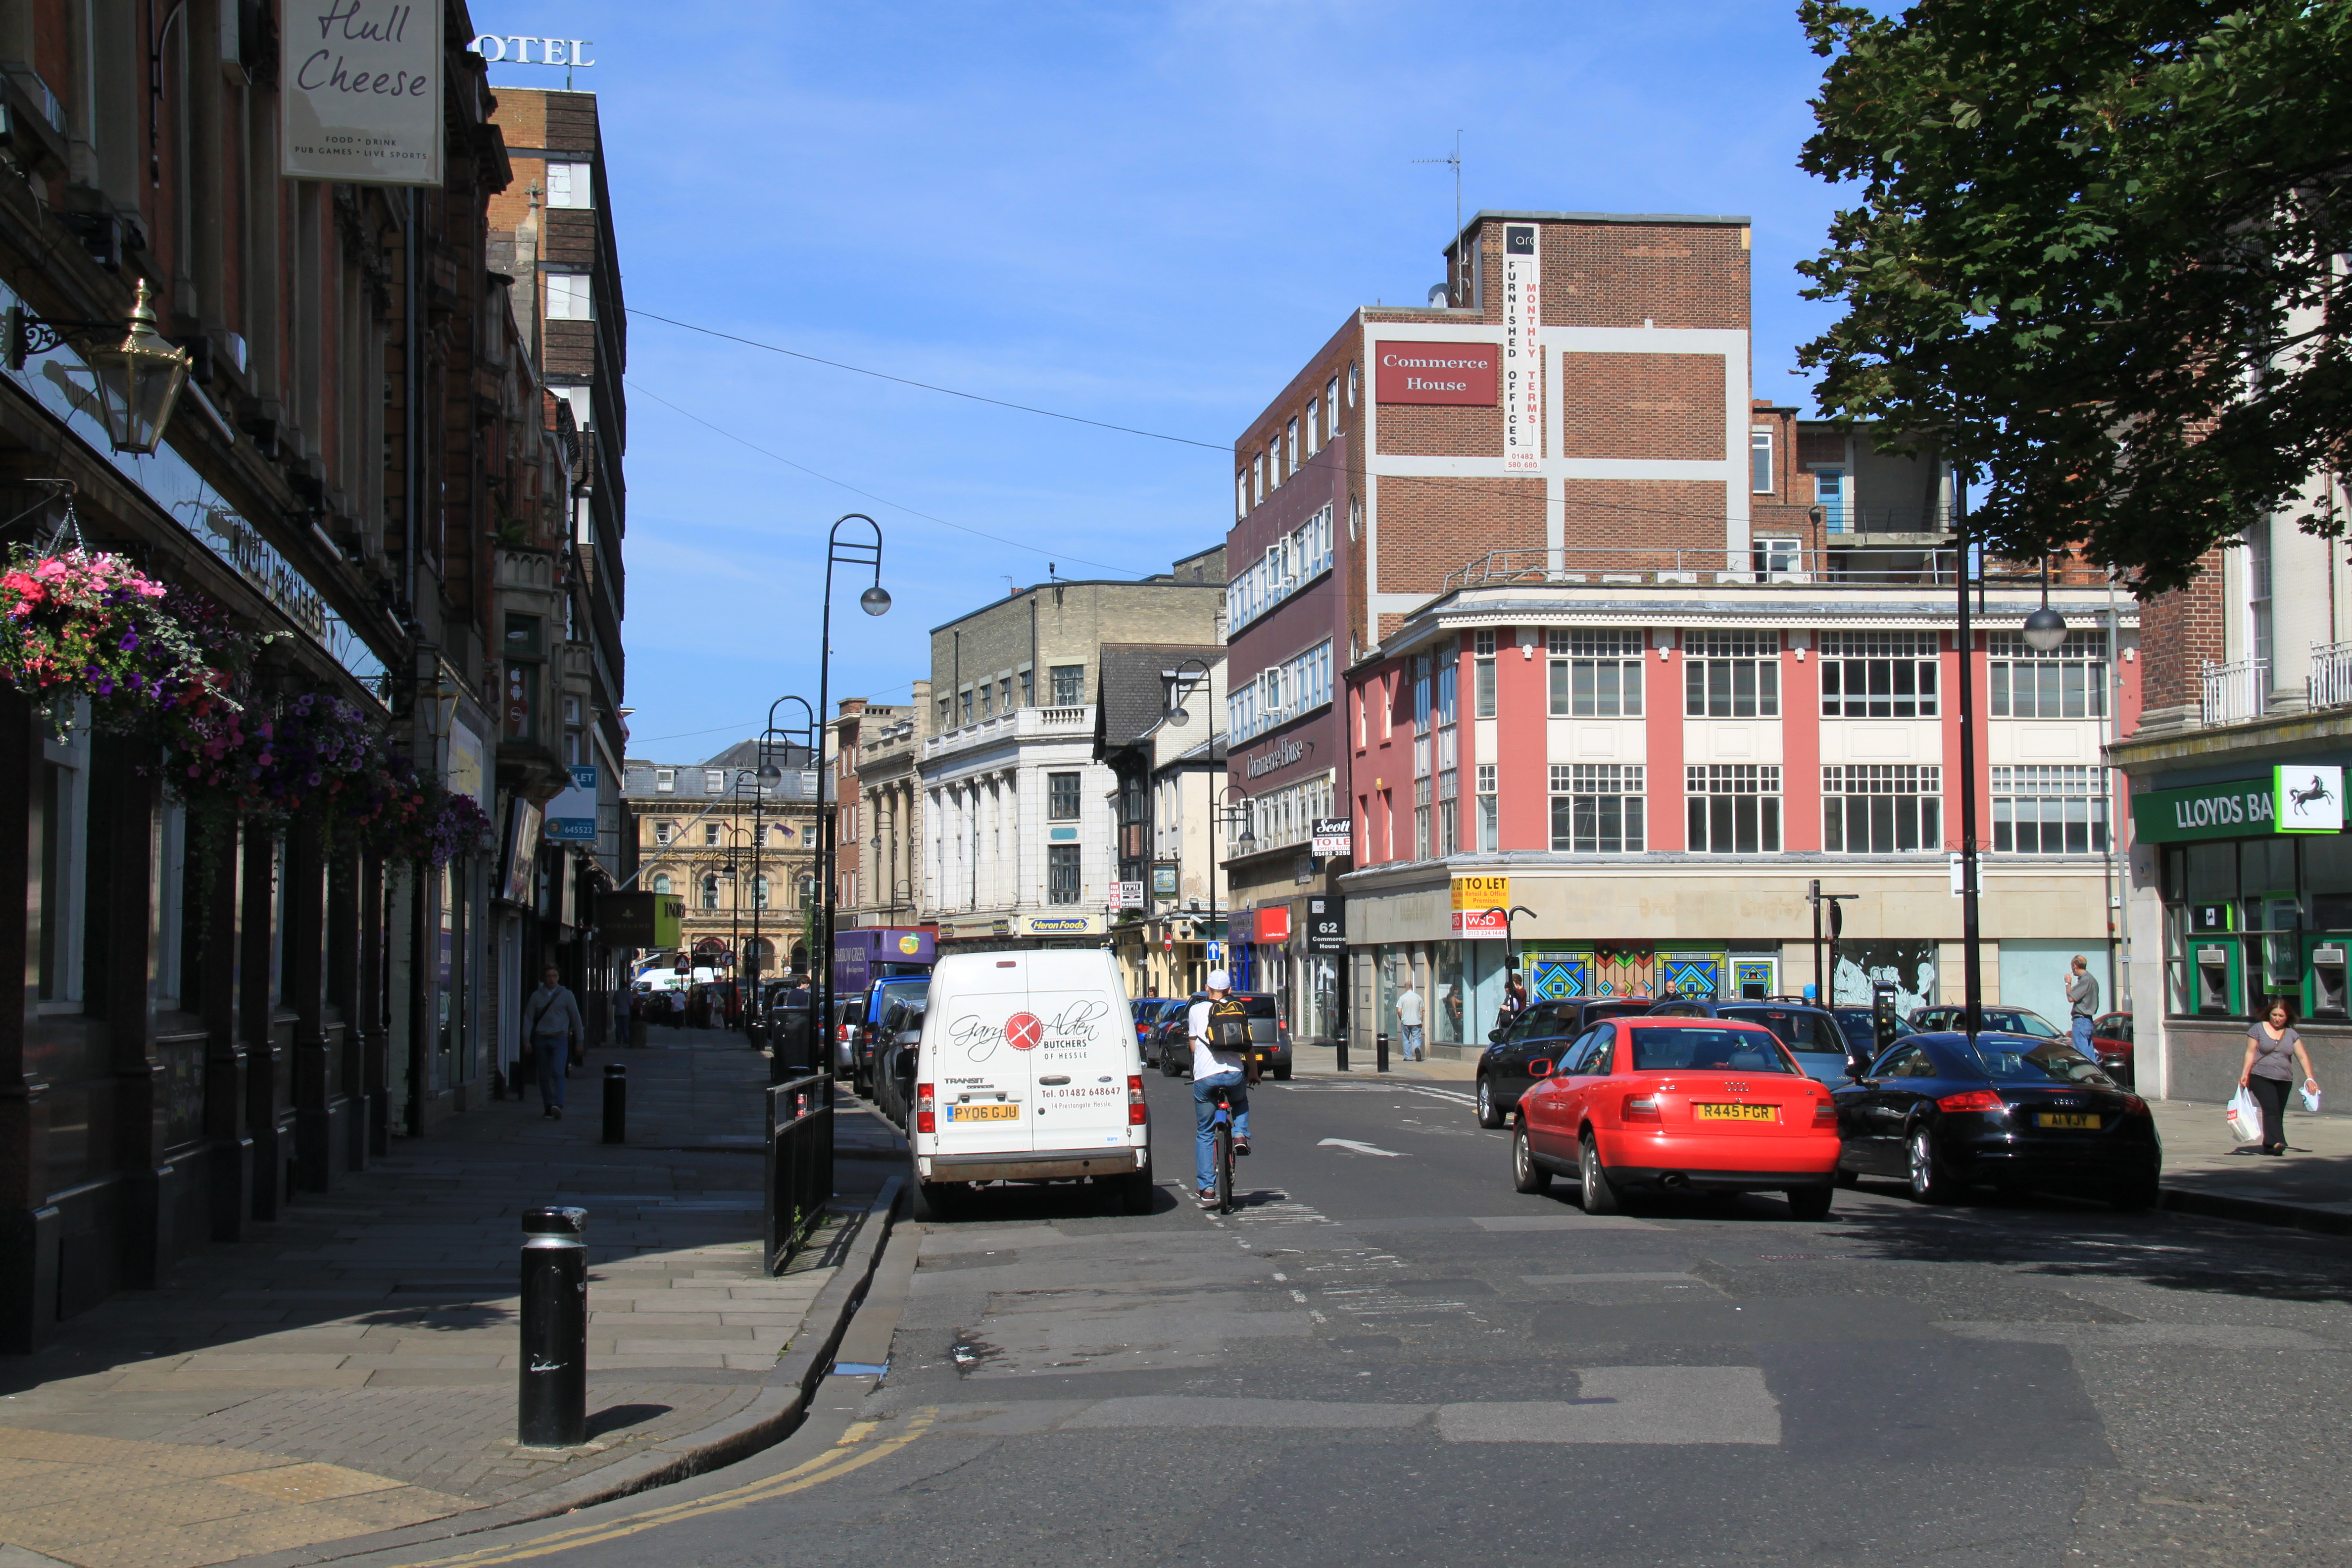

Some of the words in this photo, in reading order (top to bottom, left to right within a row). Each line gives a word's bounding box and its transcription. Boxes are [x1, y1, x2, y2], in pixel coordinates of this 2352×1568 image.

[318, 0, 410, 43] Hull
[298, 49, 427, 97] Cheese
[390, 151, 427, 159] SPORTS
[1516, 236, 1537, 246] arc
[1508, 261, 1517, 358] FURNISHED
[1526, 283, 1537, 358] MONTHLY
[1383, 354, 1489, 370] Commerce
[1406, 377, 1467, 392] House
[1528, 371, 1537, 424] TERMS
[1508, 371, 1517, 446] OFFICES
[1247, 750, 1280, 779] Commerce
[1281, 737, 1303, 766] House
[576, 773, 594, 782] LET
[2175, 795, 2243, 829] LLOYDS
[2247, 792, 2275, 822] BA
[1314, 838, 1331, 846] TO
[1465, 878, 1482, 889] TO
[1487, 878, 1506, 889] LET
[1033, 921, 1058, 930] Heron
[1059, 920, 1085, 930] Foods
[1319, 922, 1338, 933] 62
[1467, 915, 1496, 926] wsb
[834, 948, 851, 962] HARROW
[851, 947, 866, 962] GREEN
[948, 1014, 1005, 1062] Gary
[1041, 1000, 1109, 1041] Alden
[1044, 1039, 1087, 1049] BUTCHERS
[1041, 1089, 1056, 1098] Tel.
[1059, 1088, 1086, 1097] 01482
[1089, 1086, 1121, 1096] 648647
[955, 1106, 988, 1119] PY06
[992, 1106, 1017, 1118] GJU
[1704, 1105, 1740, 1118] R445
[1743, 1106, 1769, 1119] FGR
